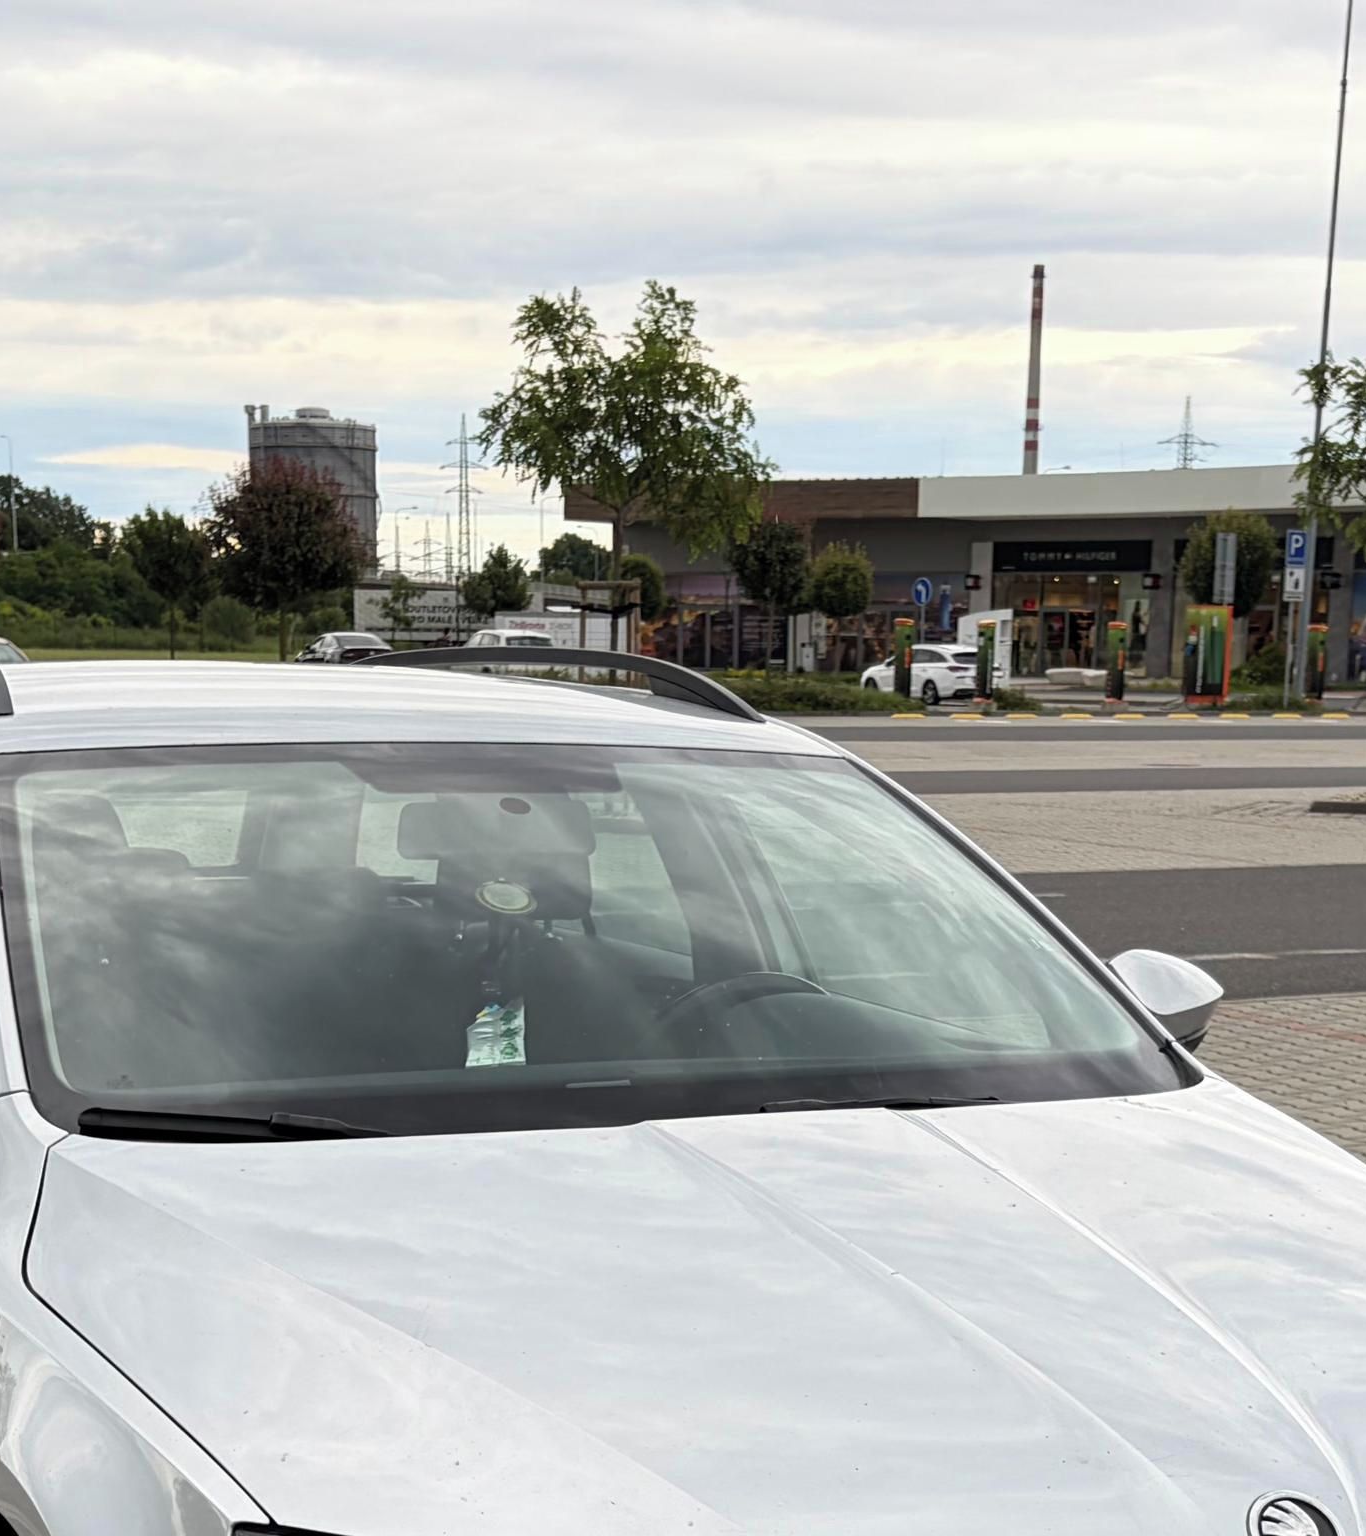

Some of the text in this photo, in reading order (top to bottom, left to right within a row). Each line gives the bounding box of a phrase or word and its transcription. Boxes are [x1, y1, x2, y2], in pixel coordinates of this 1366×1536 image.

[1290, 534, 1304, 555] P
[1022, 551, 1117, 561] TOMMY HILFIGER
